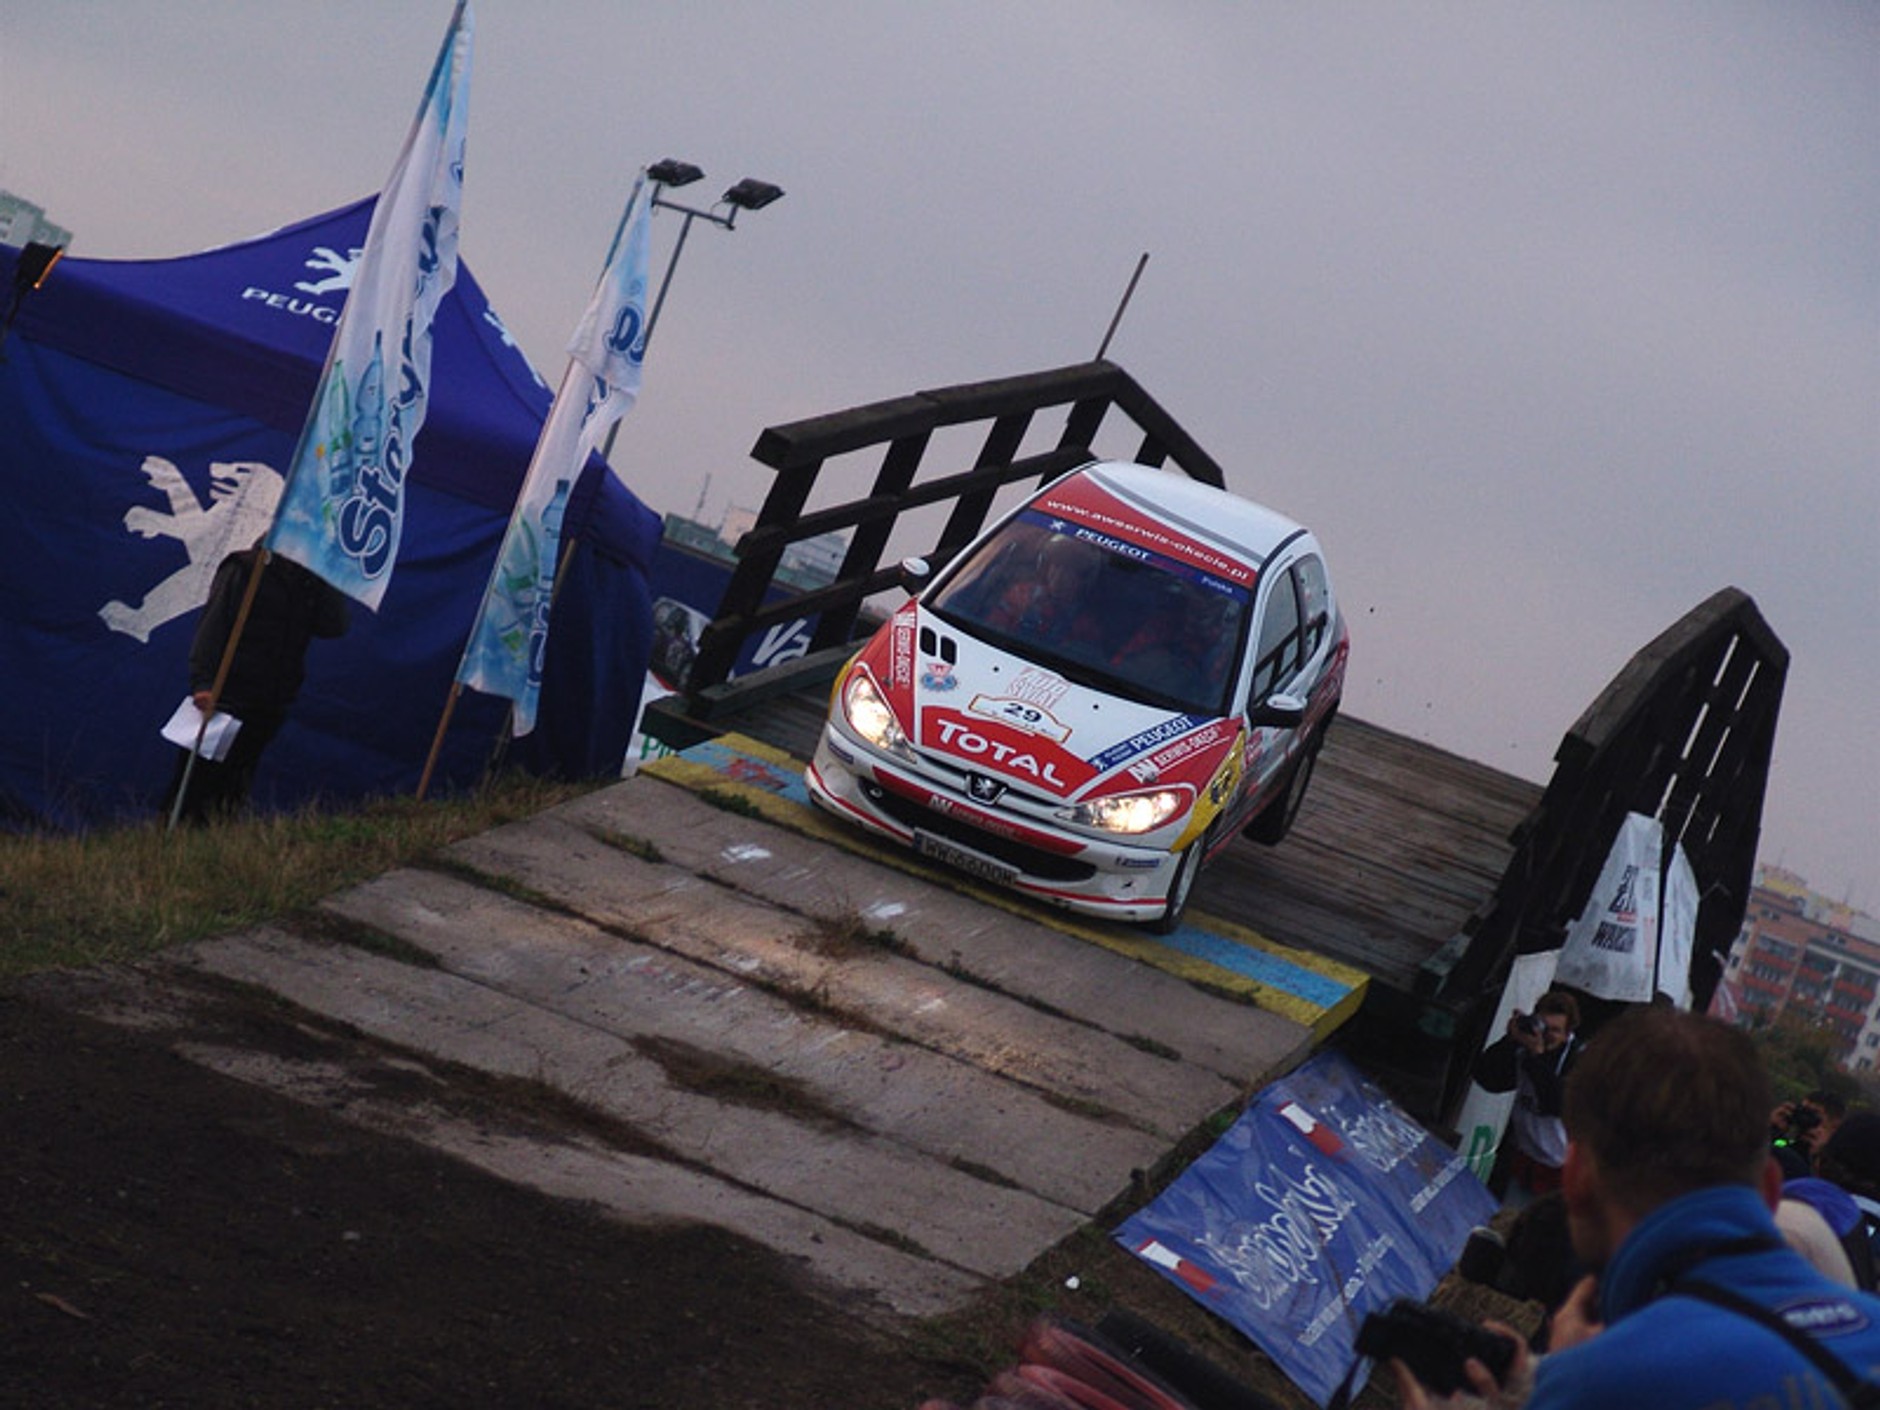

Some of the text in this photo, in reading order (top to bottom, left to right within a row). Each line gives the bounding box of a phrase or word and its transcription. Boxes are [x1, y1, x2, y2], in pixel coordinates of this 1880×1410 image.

[241, 286, 341, 326] PEUG
[1075, 527, 1150, 560] PEUGEOT
[1003, 702, 1042, 723] 29
[1128, 715, 1194, 751] PEUGEOT
[936, 718, 1066, 788] TOTAL
